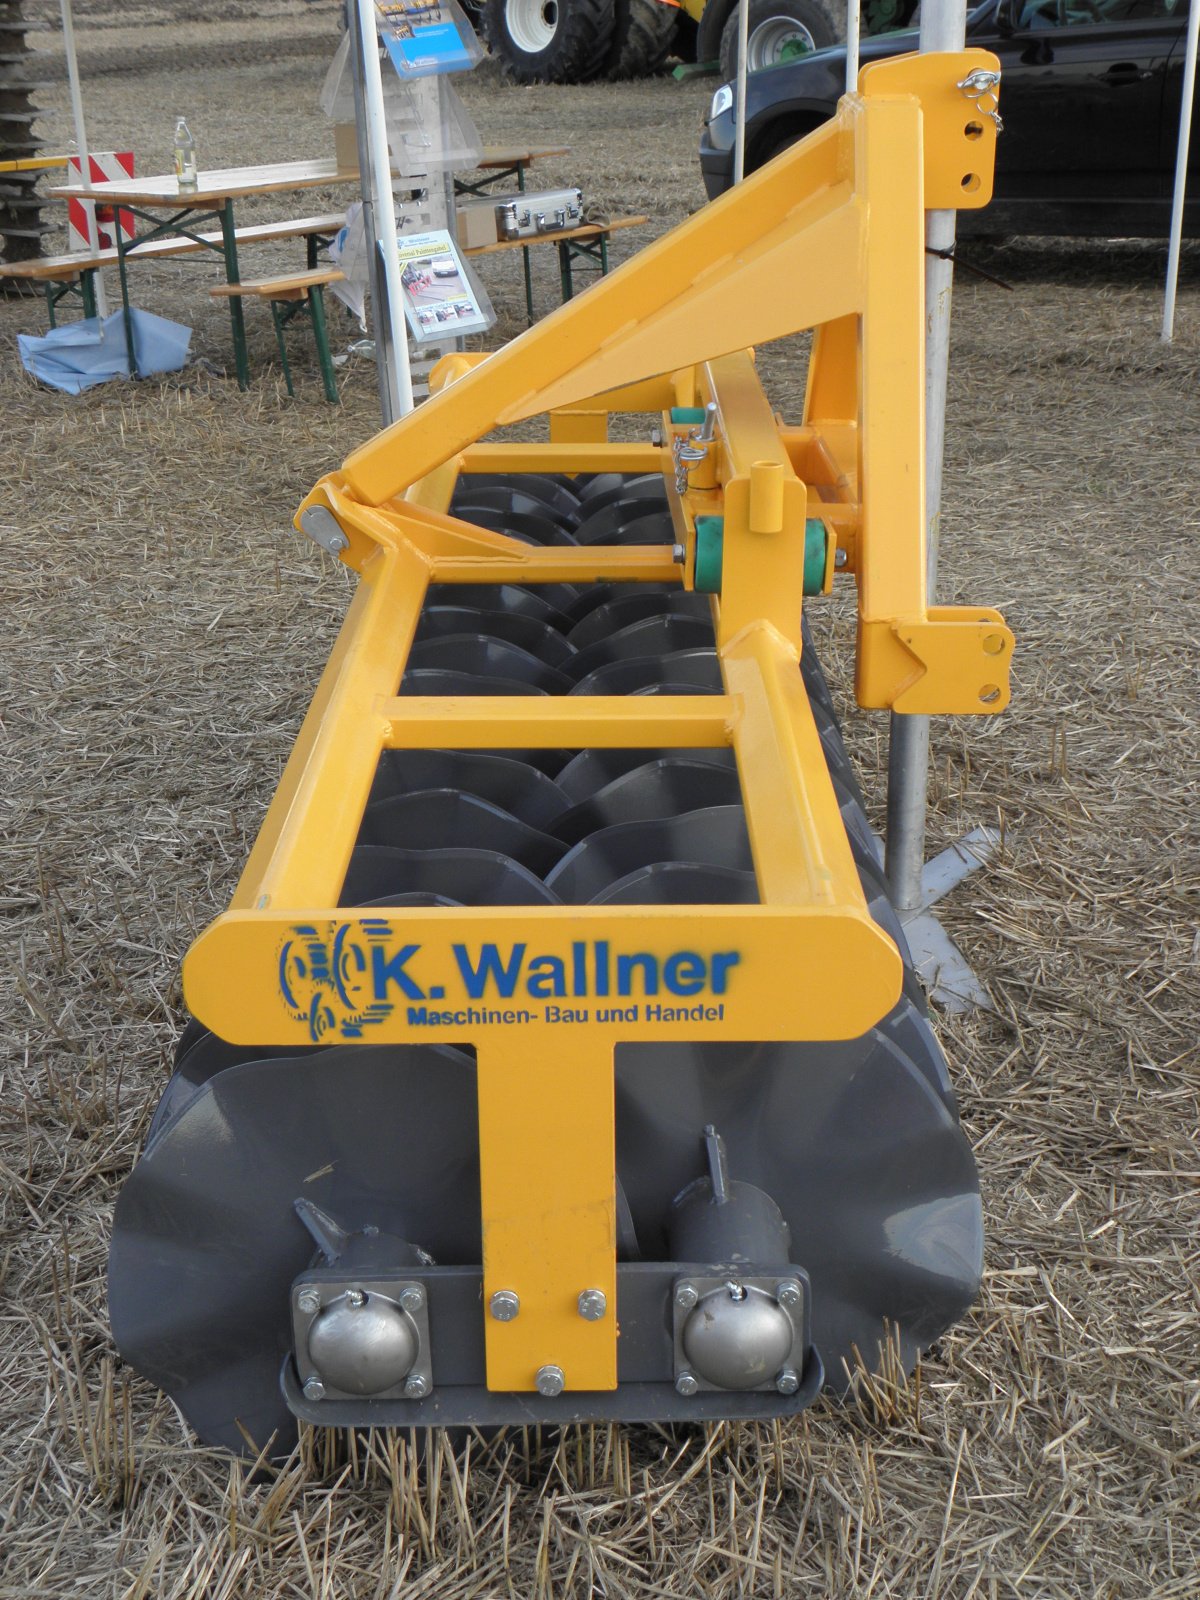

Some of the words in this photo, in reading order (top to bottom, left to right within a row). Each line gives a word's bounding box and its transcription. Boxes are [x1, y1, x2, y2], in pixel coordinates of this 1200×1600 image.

[371, 944, 446, 1001] K.
[451, 941, 741, 999] Wallner
[407, 1007, 538, 1025] Maschinen-
[545, 1006, 589, 1023] Bau
[596, 1005, 639, 1022] und
[646, 1004, 724, 1022] Handel
